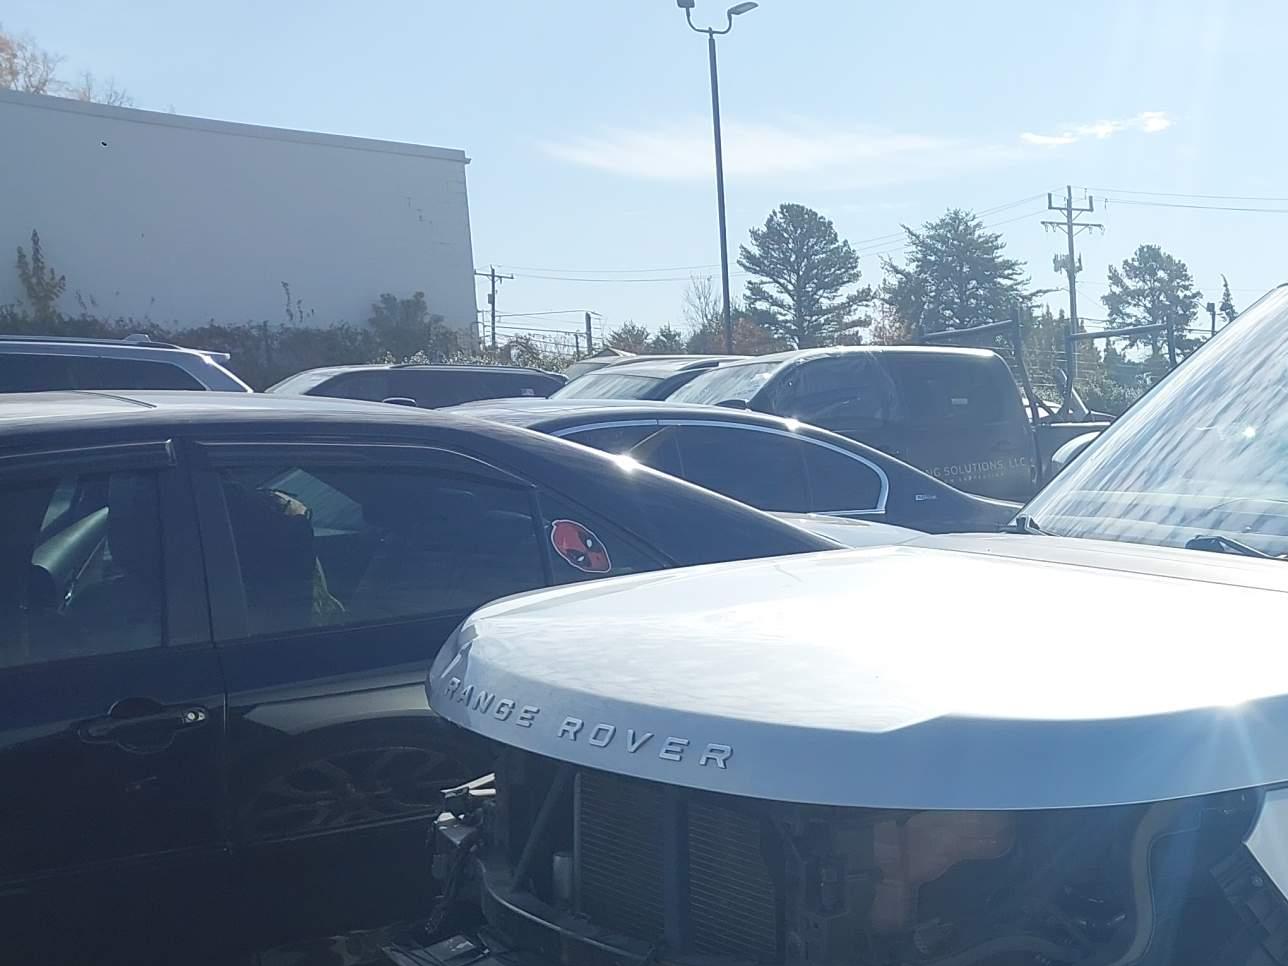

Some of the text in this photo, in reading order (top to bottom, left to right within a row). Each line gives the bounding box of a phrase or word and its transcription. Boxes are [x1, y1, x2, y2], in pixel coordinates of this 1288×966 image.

[943, 459, 1004, 476] SOLUTIONS
[1008, 457, 1026, 468] LLC
[444, 677, 734, 770] RANGE ROVER
